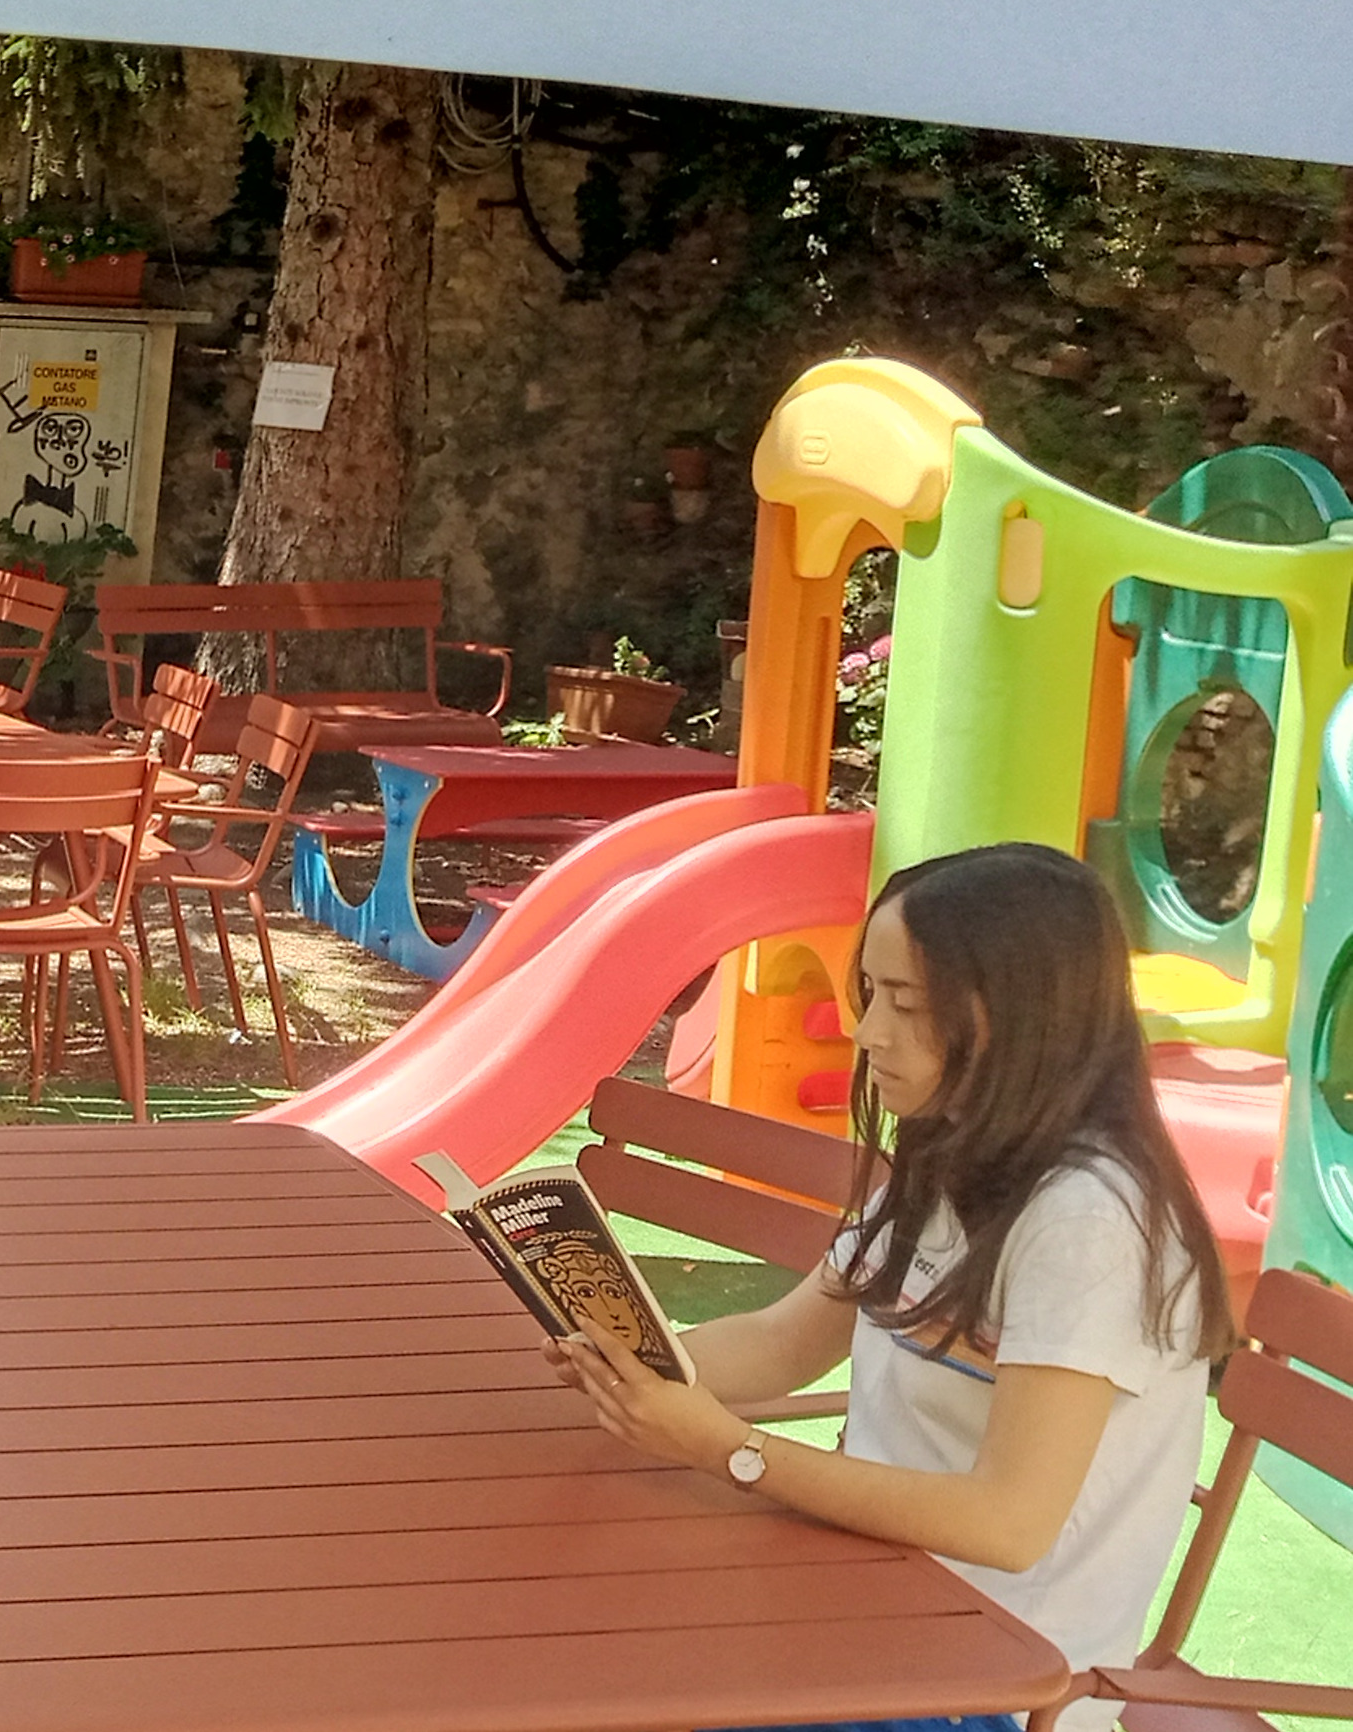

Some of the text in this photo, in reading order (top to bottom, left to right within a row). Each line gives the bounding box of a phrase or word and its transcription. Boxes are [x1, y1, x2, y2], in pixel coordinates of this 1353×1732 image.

[34, 367, 97, 380] CONTATORE
[53, 382, 76, 393] GAS
[42, 396, 86, 408] METANO
[490, 1193, 563, 1222] Madeline
[500, 1211, 550, 1235] Miller
